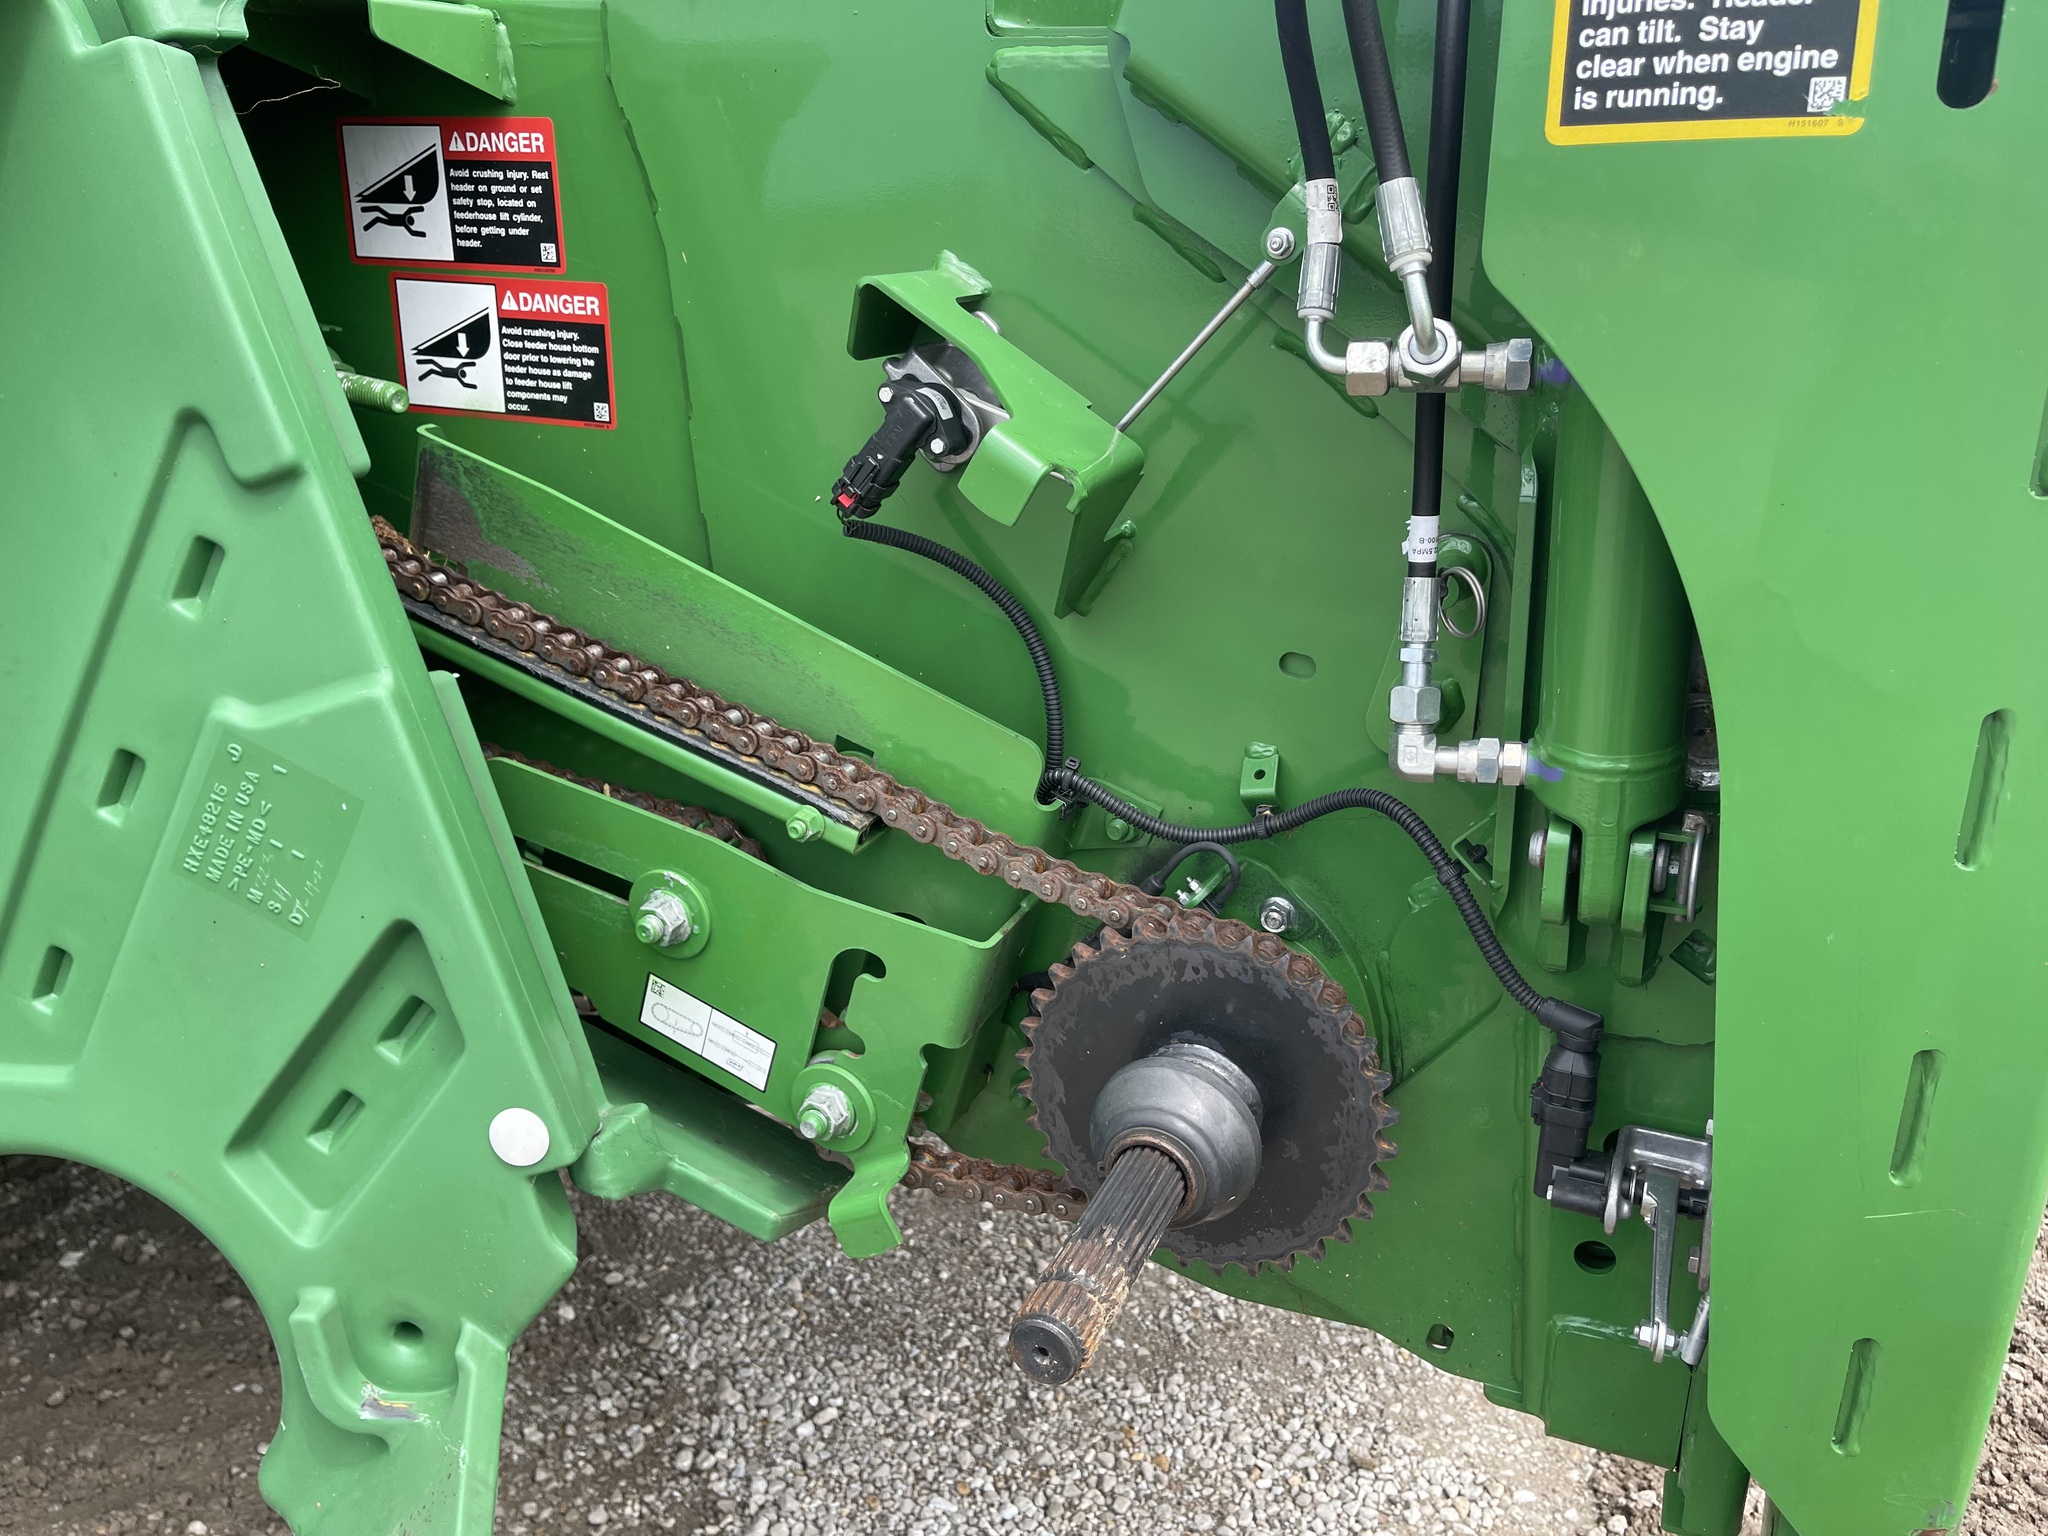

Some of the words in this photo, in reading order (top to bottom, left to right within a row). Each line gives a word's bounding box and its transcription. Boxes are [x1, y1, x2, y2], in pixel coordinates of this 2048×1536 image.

[1579, 25, 1628, 49] can
[1638, 18, 1682, 44] tilt.
[1698, 16, 1764, 45] Stay
[1576, 54, 1644, 80] clear
[1653, 50, 1728, 76] when
[1736, 45, 1839, 78] engine
[1573, 87, 1597, 110] is
[1605, 82, 1723, 111] running.
[465, 132, 545, 153] DANGER
[450, 168, 469, 177] Avoid
[472, 169, 503, 180] crushing
[506, 170, 529, 180] injury.
[532, 170, 549, 180] Rest
[451, 183, 475, 191] header
[491, 184, 516, 194] ground
[531, 185, 542, 194] set
[452, 197, 474, 207] safety
[477, 198, 494, 208] stop,
[497, 198, 523, 207] located
[454, 211, 497, 221] feederhouse
[500, 212, 510, 221] lift
[513, 213, 543, 223] cylinder,
[455, 225, 477, 233] before
[481, 226, 505, 236] getting
[508, 227, 529, 235] under
[457, 238, 482, 247] header.
[519, 292, 600, 316] DANGER
[501, 326, 522, 335] Avoid
[523, 328, 555, 339] crushing
[557, 330, 579, 341] injury.
[502, 339, 523, 348] Close
[524, 340, 547, 350] feeder
[549, 342, 571, 351] house
[573, 344, 599, 354] bottom
[503, 352, 520, 360] door
[522, 354, 539, 362] prior
[541, 355, 548, 363] to
[550, 356, 581, 367] lowering
[582, 358, 594, 366] the
[504, 364, 527, 373] feeder
[529, 366, 551, 375] house
[563, 369, 592, 380] damage
[515, 378, 537, 387] feeder
[539, 380, 561, 389] house
[562, 382, 572, 390] lift
[507, 391, 551, 401] components
[552, 394, 567, 404] may
[205, 834, 234, 883] MADE
[226, 810, 244, 832] IN
[235, 770, 260, 806] USA
